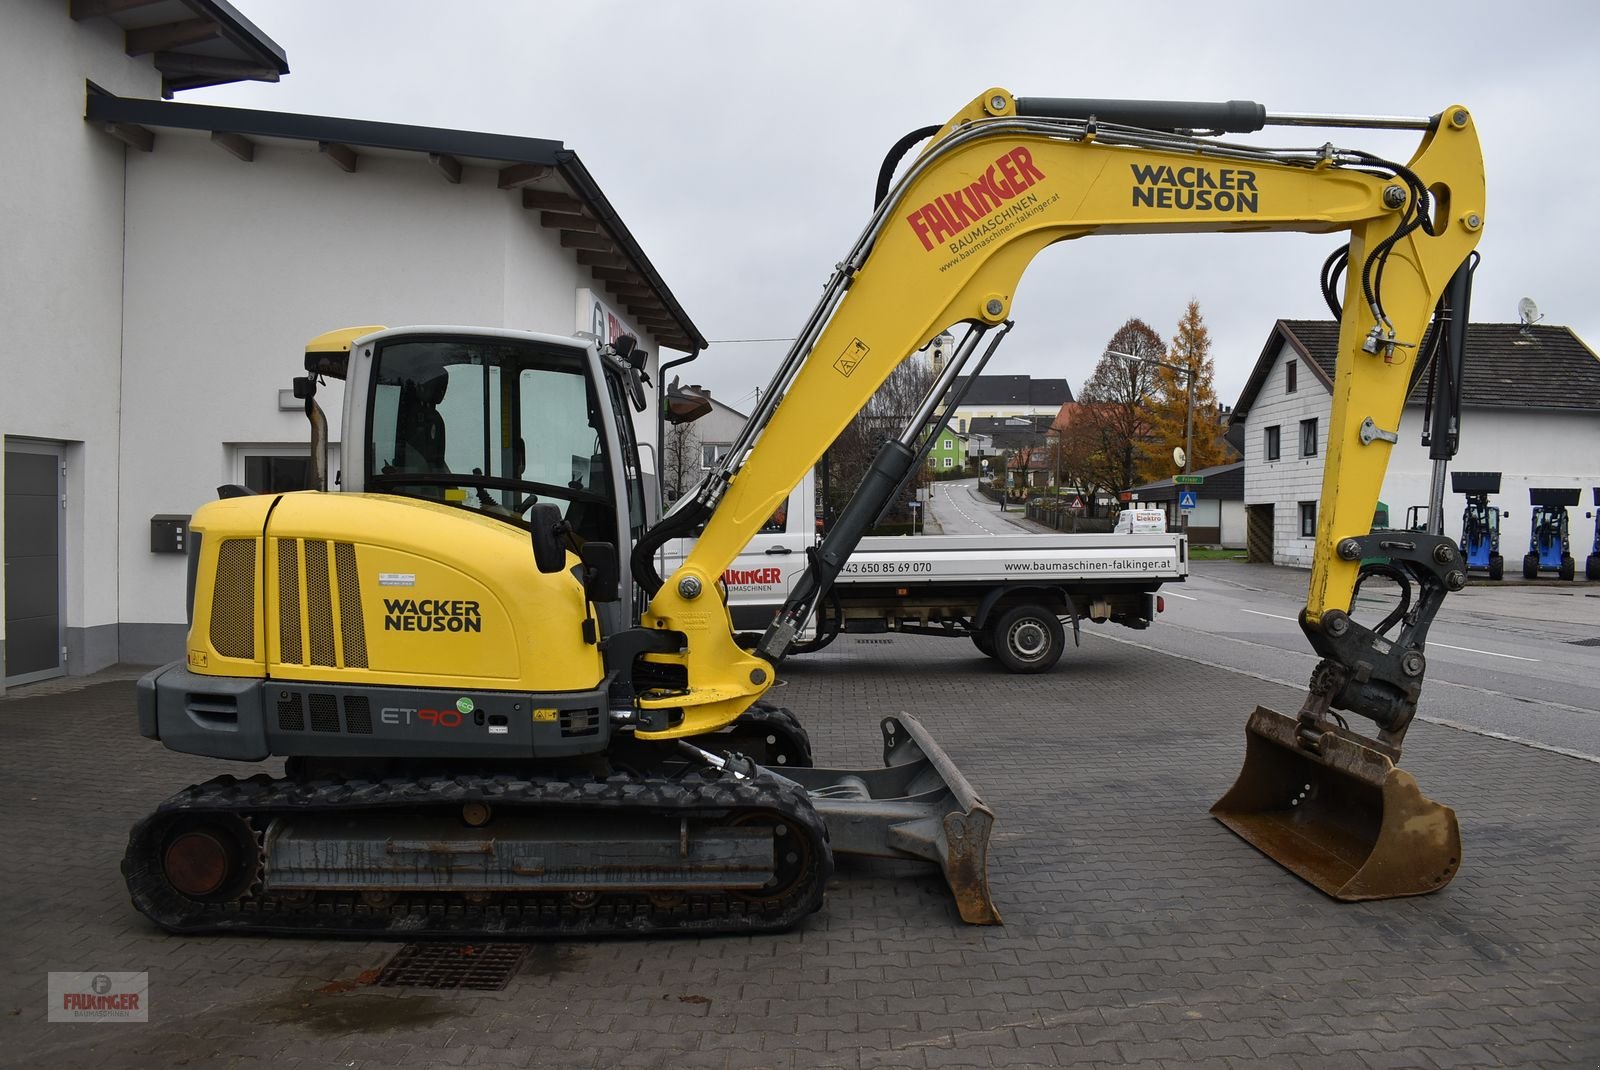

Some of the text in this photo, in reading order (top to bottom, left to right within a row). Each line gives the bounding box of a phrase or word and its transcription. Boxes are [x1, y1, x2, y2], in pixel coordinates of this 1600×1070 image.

[1130, 164, 1259, 192] WACKER
[906, 146, 1046, 252] FALKINGER
[1132, 186, 1259, 213] NEUSON
[939, 192, 1061, 273] www.baumaschinen-falkinger.at
[949, 193, 1038, 254] BAUMASCHINEN
[720, 568, 781, 584] LKINGER
[861, 563, 880, 573] 650
[882, 563, 895, 573] 85
[898, 562, 910, 572] 69
[913, 562, 932, 572] 070
[1004, 559, 1171, 572] www.baumaschinen-falkinger.at
[383, 599, 481, 616] WACKER
[384, 615, 482, 632] NEUSON
[381, 707, 464, 728] ET90
